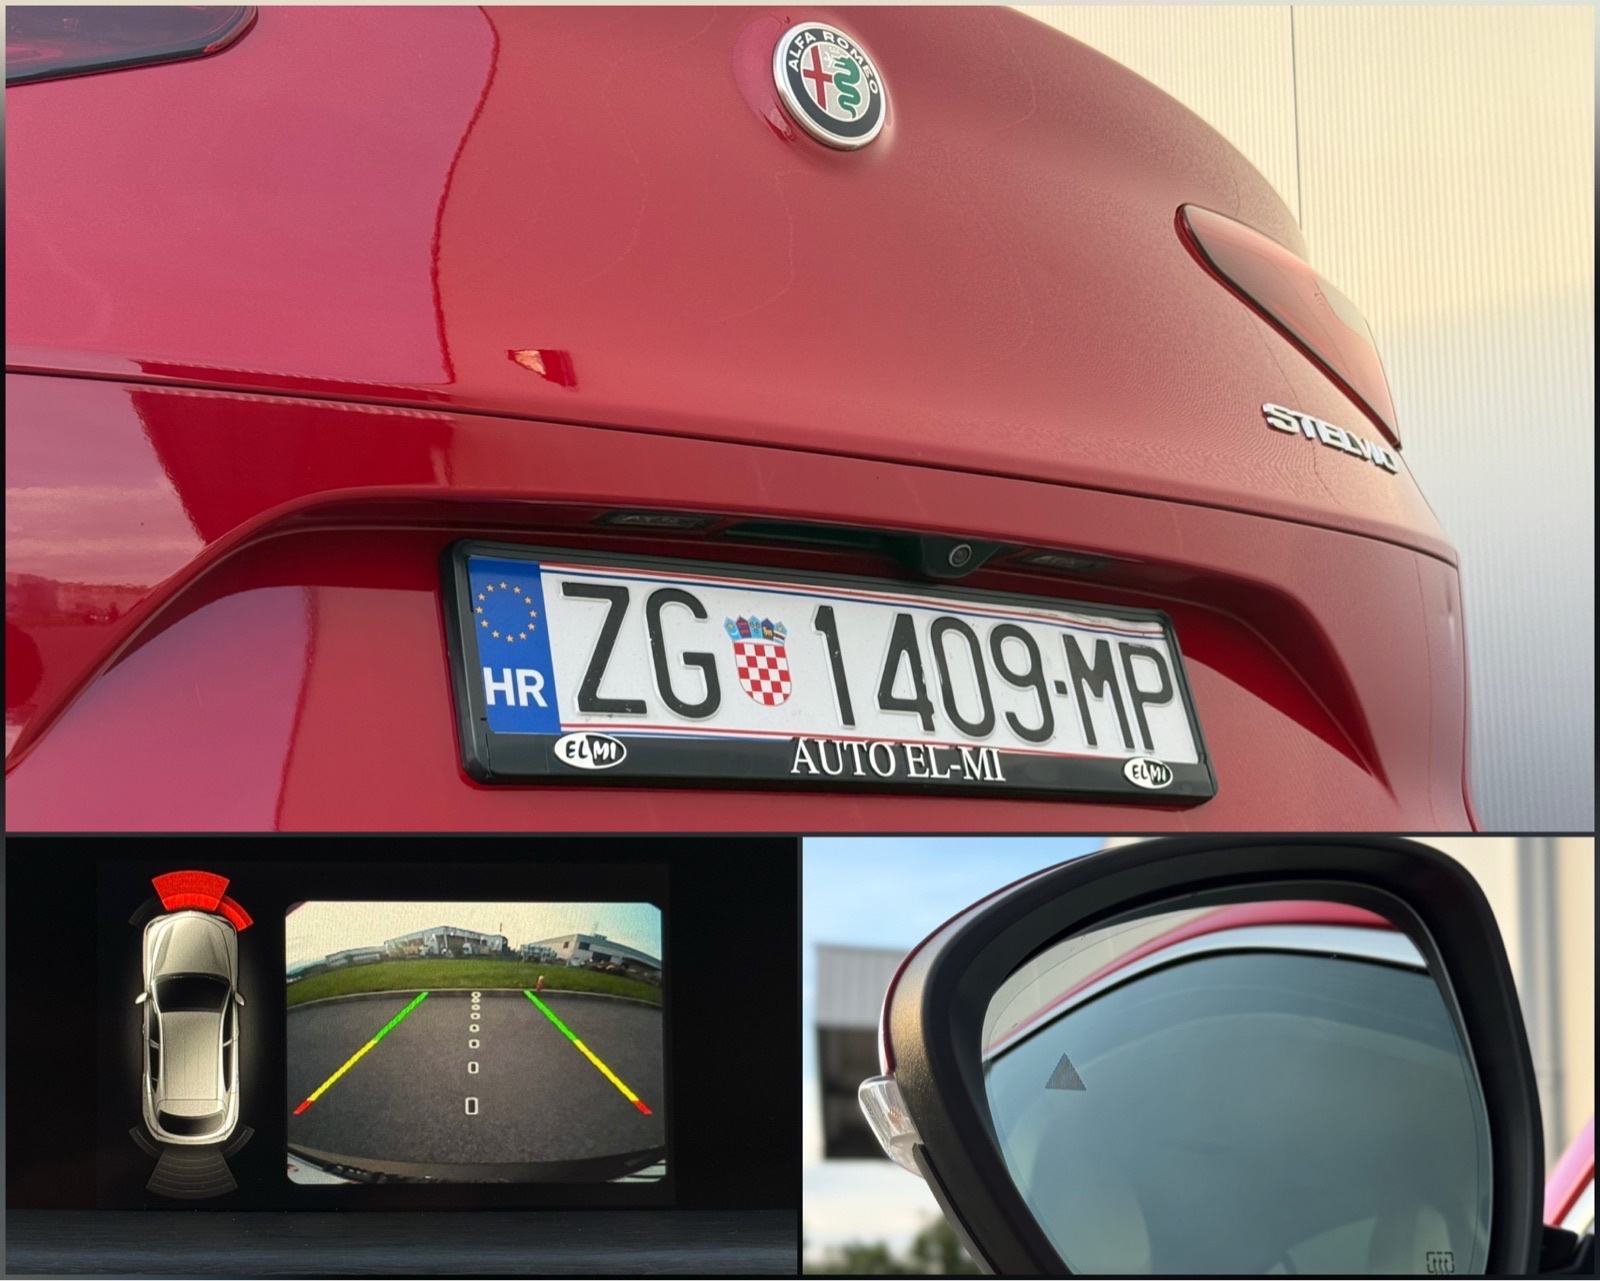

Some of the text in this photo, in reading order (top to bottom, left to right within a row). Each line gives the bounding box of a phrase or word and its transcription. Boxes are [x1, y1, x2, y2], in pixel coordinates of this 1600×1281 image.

[788, 30, 878, 94] ALFA ROMEO
[561, 581, 722, 720] ZG
[483, 667, 548, 708] HR
[791, 738, 1007, 782] AUTO EL-MI
